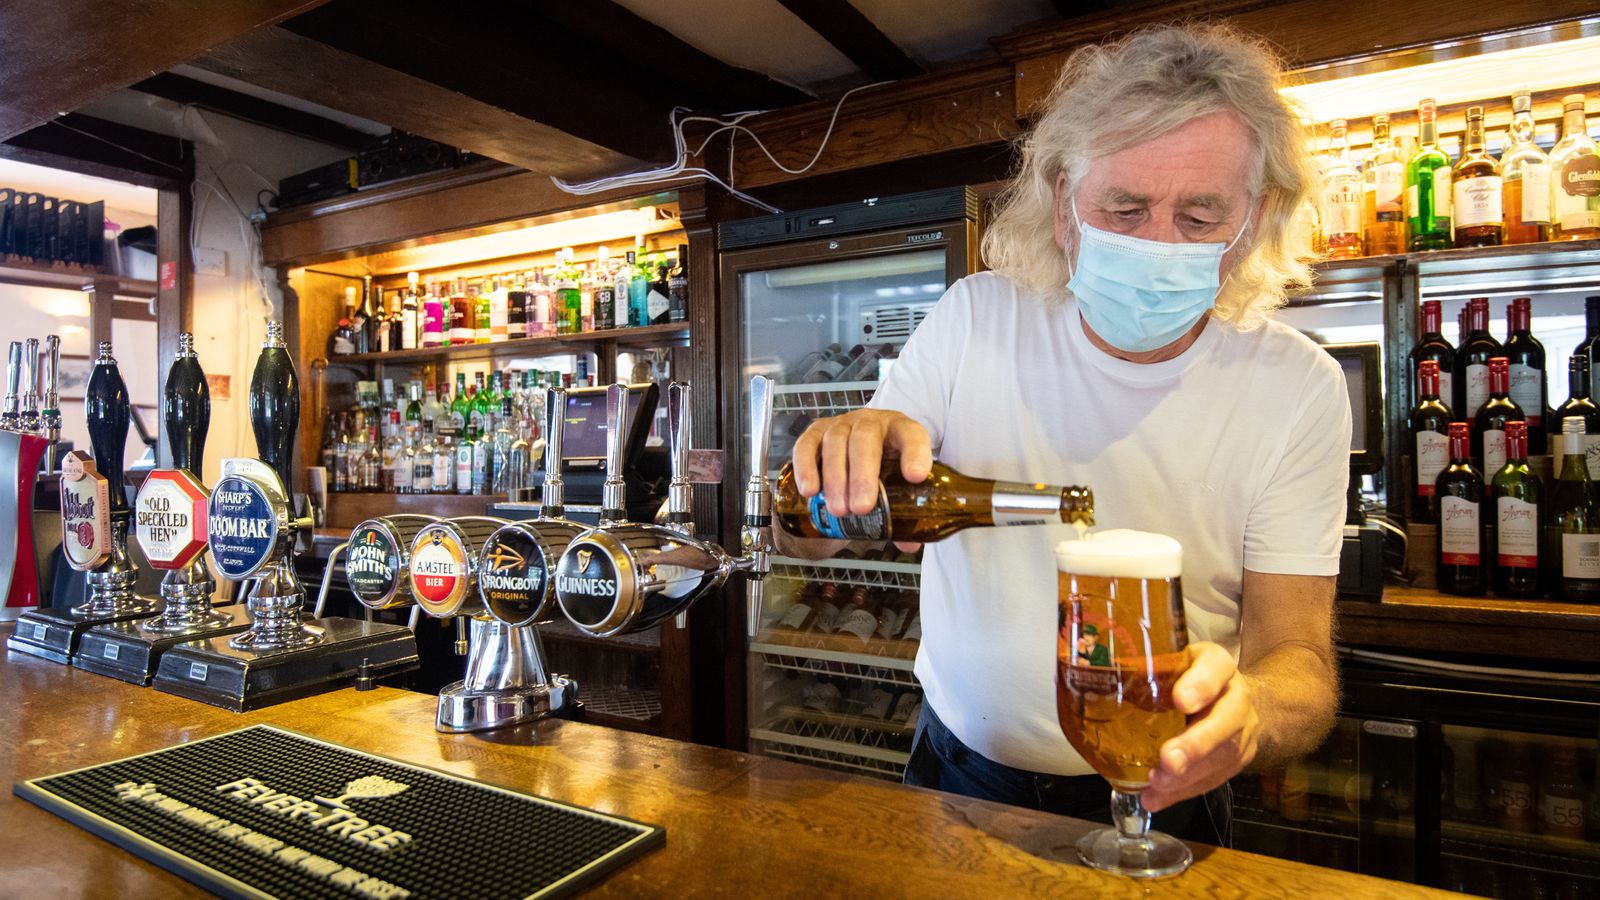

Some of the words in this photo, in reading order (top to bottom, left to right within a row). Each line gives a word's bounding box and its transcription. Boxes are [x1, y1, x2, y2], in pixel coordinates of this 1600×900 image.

[218, 491, 252, 505] SHARP'S
[138, 511, 188, 527] SPECKLED
[210, 515, 238, 537] DOOM
[240, 518, 270, 539] BAR
[351, 545, 386, 563] JOHN
[346, 558, 392, 581] SMITH'S
[416, 561, 453, 574] AMSTEL
[425, 577, 443, 587] BIER
[482, 572, 541, 591] STRONGBOW
[558, 574, 615, 597] GUINNESS
[490, 592, 529, 600] ORIGINAL
[215, 777, 412, 851] FEVER-TREE
[1554, 806, 1582, 826] 55
